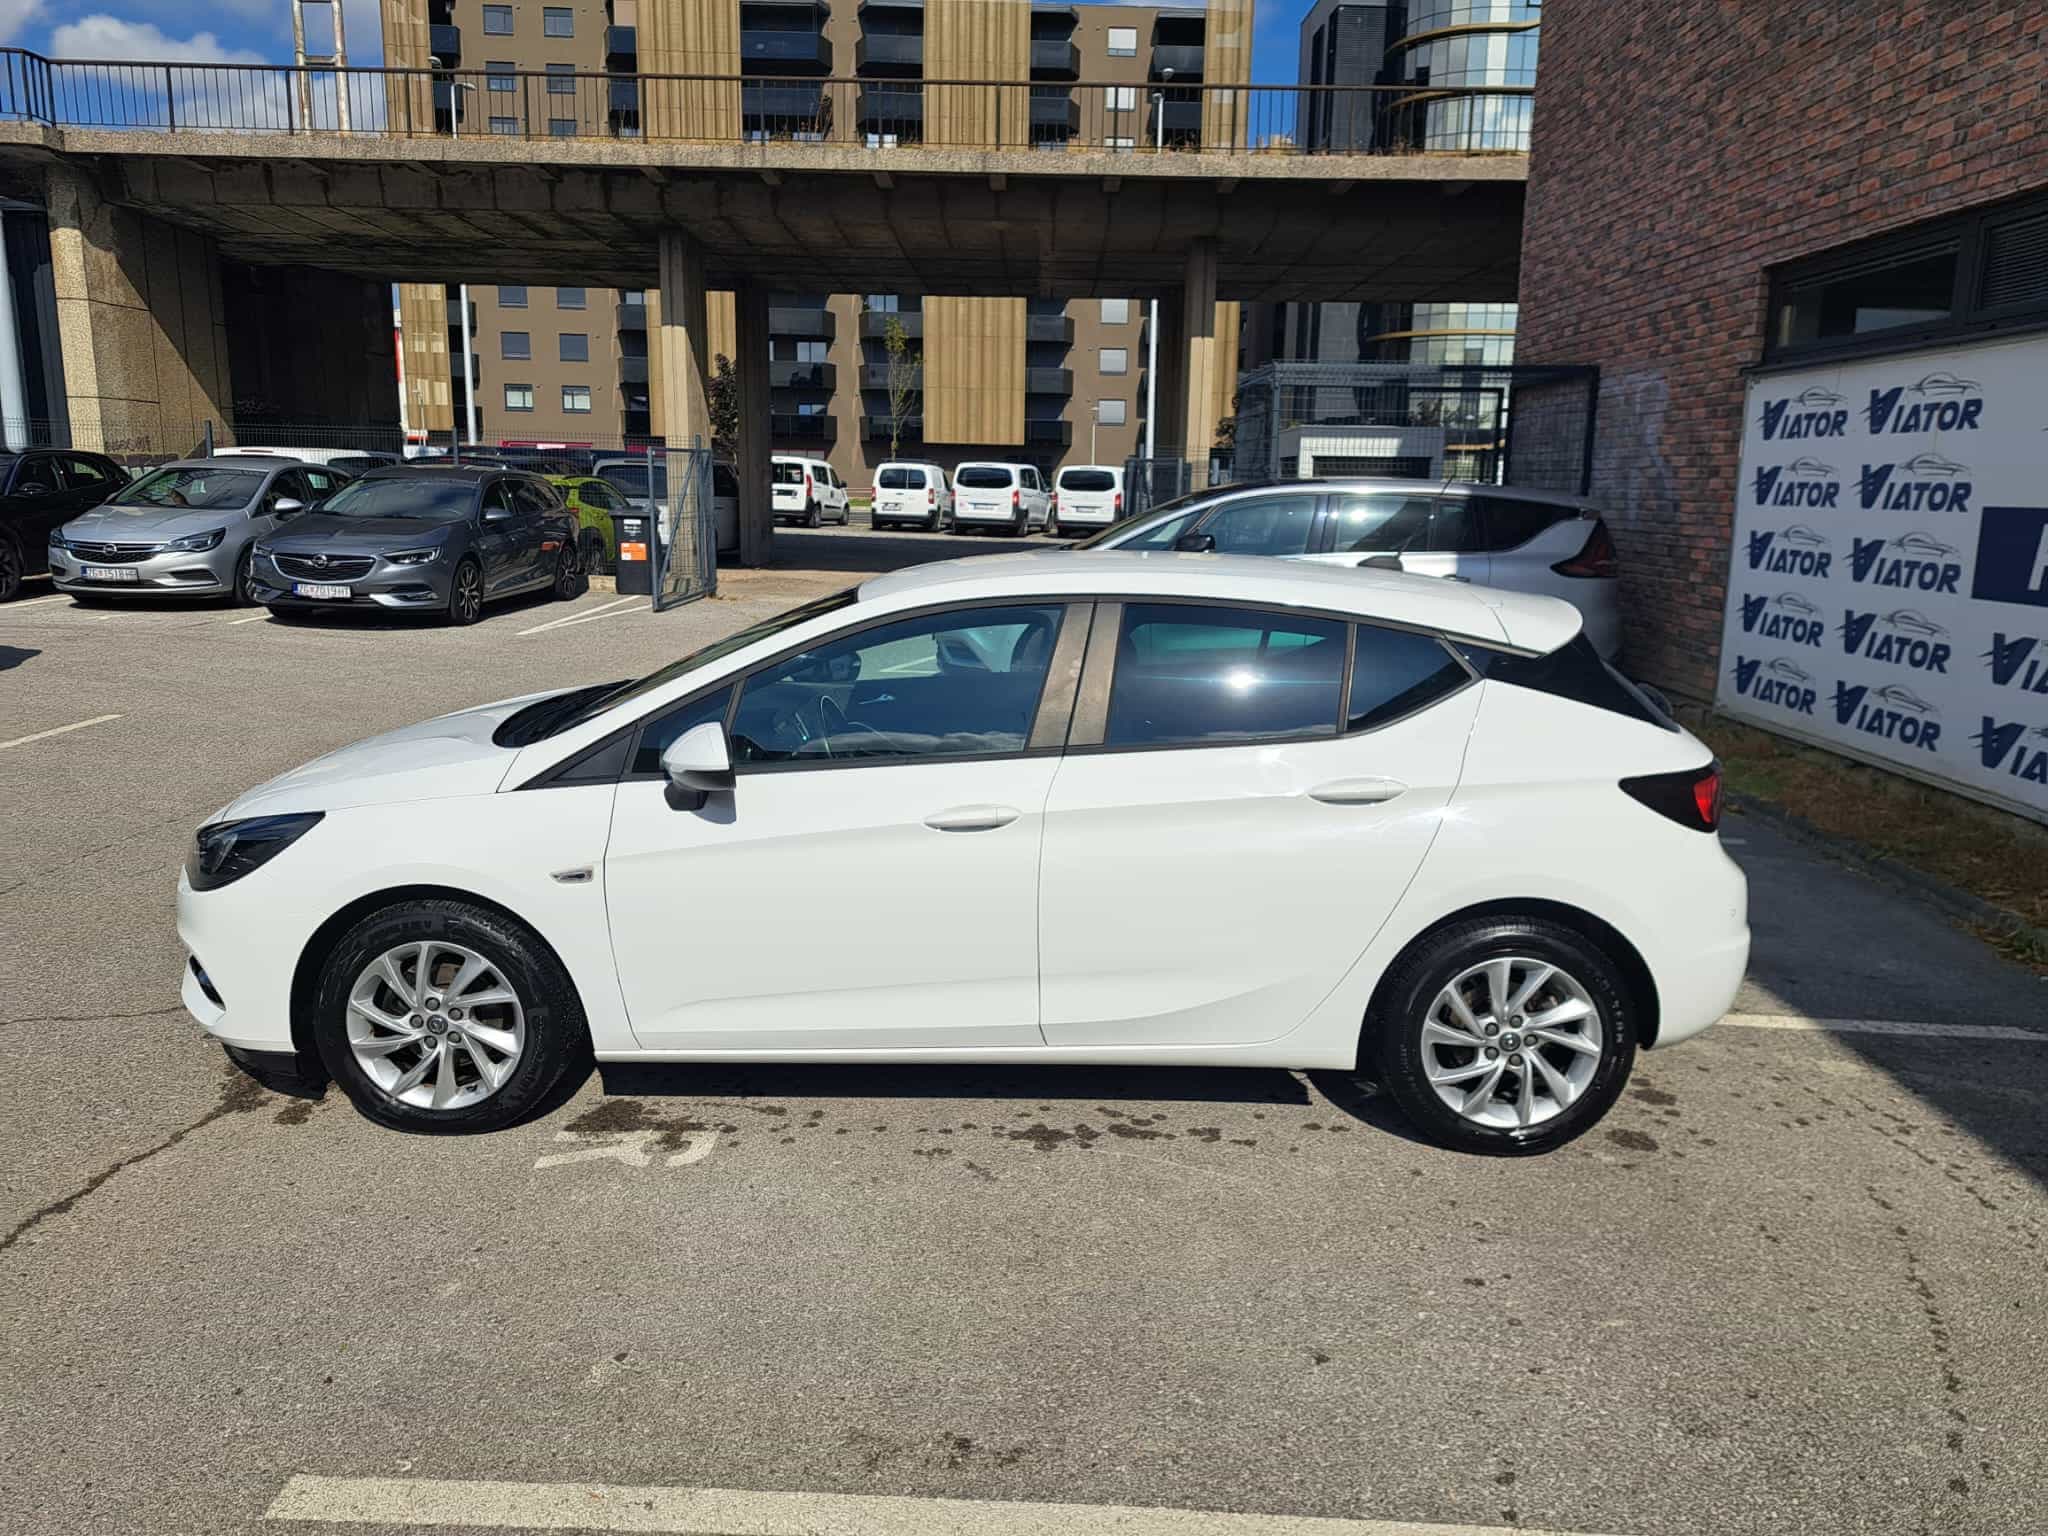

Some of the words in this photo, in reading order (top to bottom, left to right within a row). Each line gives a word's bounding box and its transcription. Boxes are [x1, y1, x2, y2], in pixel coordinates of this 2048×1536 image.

[1758, 398, 1848, 440] VIATOR
[1862, 386, 1983, 435] VIATOR
[1751, 465, 1840, 509] VIATOR
[1853, 463, 1972, 513] VIATOR
[1746, 530, 1832, 579] VIATOR
[1845, 537, 1962, 595] VIATOR
[1737, 593, 1825, 648] VIATOR
[1836, 609, 1952, 675] VIATOR
[1730, 655, 1816, 715] VIATOR
[1826, 679, 1942, 752] VIATOR
